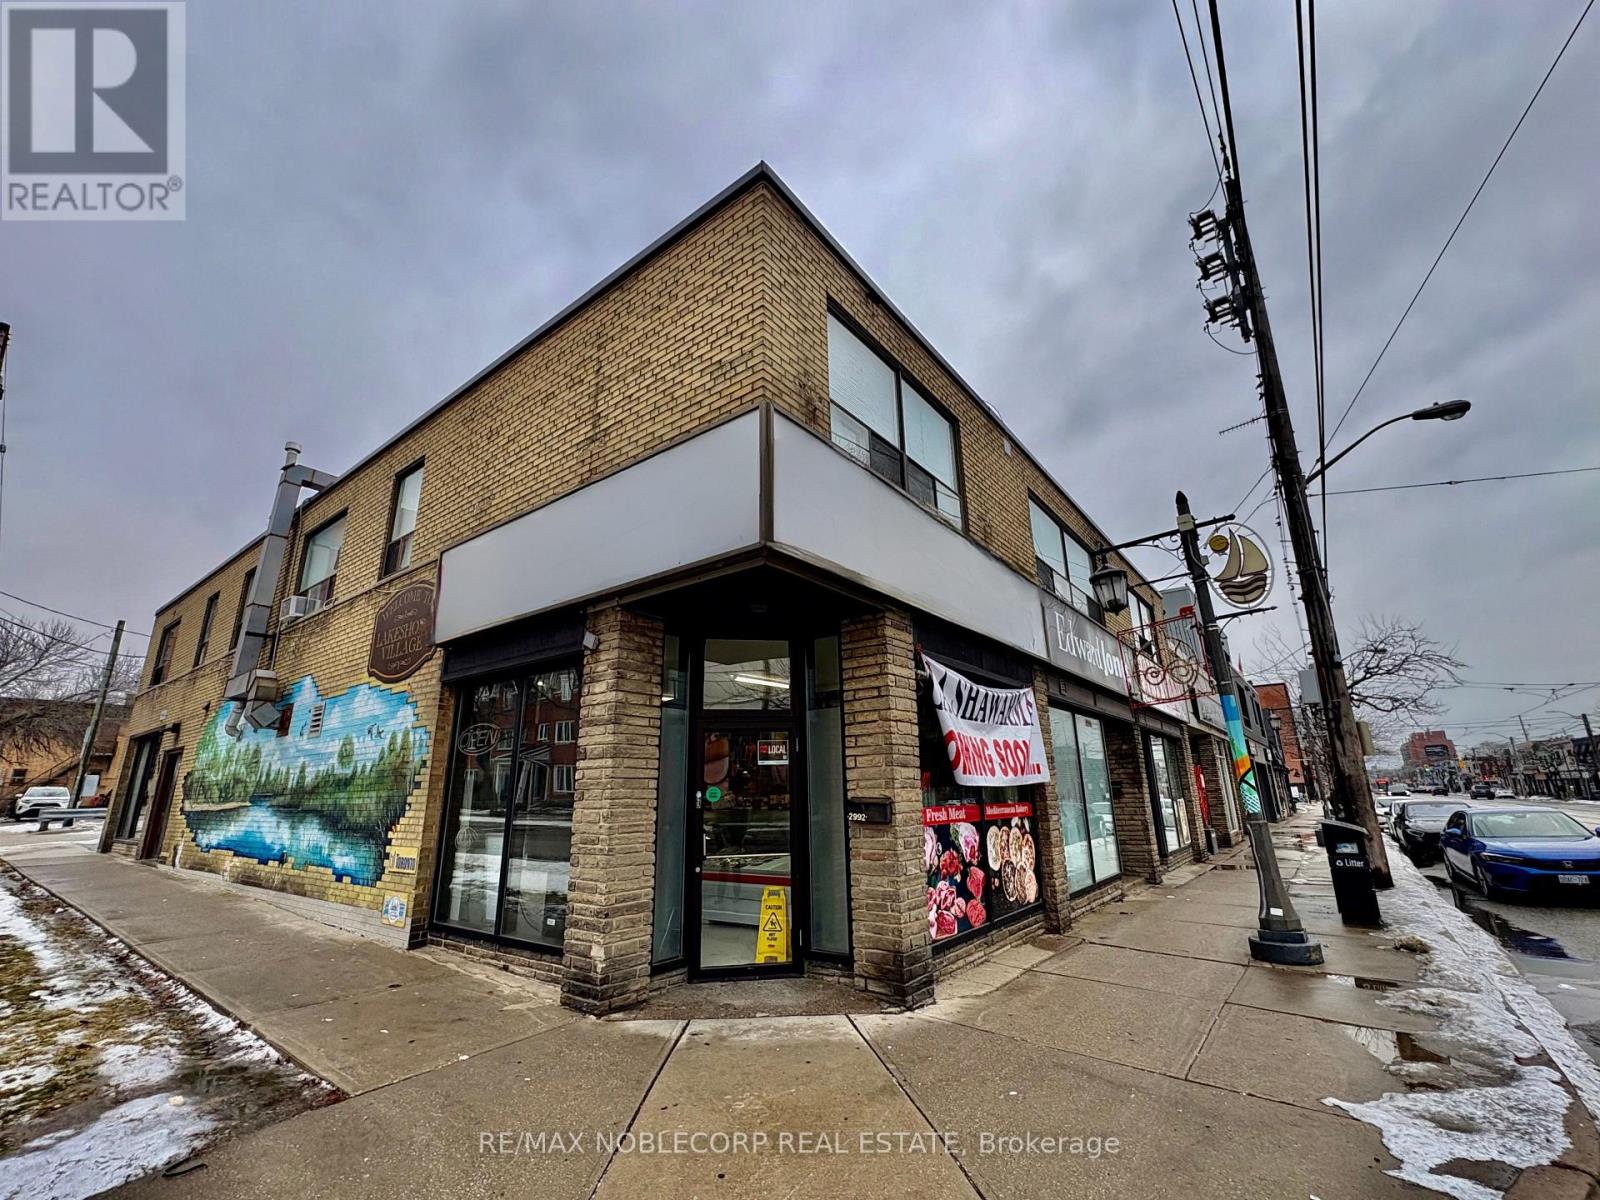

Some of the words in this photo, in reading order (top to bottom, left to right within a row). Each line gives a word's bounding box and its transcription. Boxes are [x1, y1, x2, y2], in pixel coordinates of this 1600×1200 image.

[382, 637, 423, 660] VILLAGE
[768, 744, 787, 754] LOCAL
[848, 812, 866, 822] 2992
[925, 807, 948, 823] Fresh
[948, 807, 966, 820] Meat
[1344, 858, 1365, 868] Litter
